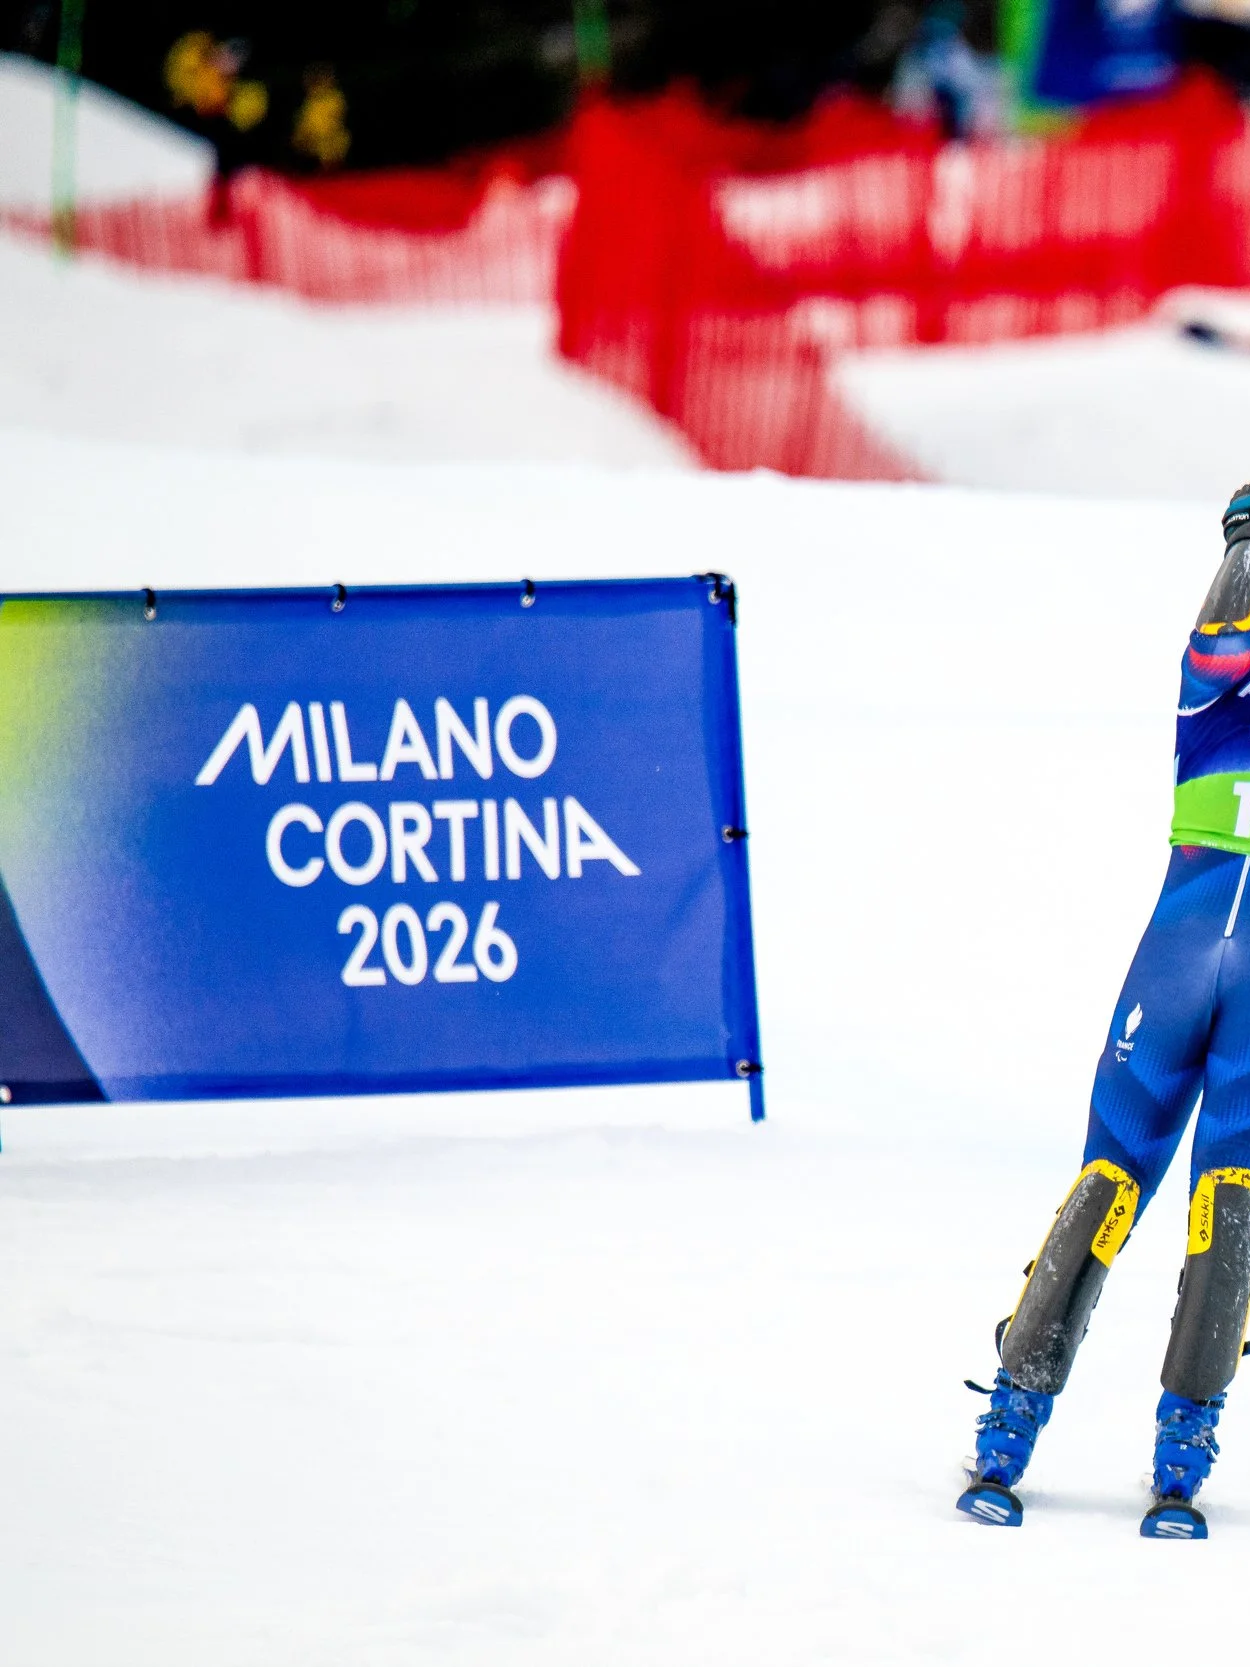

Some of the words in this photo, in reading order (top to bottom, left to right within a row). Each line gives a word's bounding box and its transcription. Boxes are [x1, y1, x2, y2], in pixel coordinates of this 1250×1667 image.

[196, 695, 557, 786] MILANO
[266, 797, 642, 887] CORTINA
[338, 902, 518, 987] 2026
